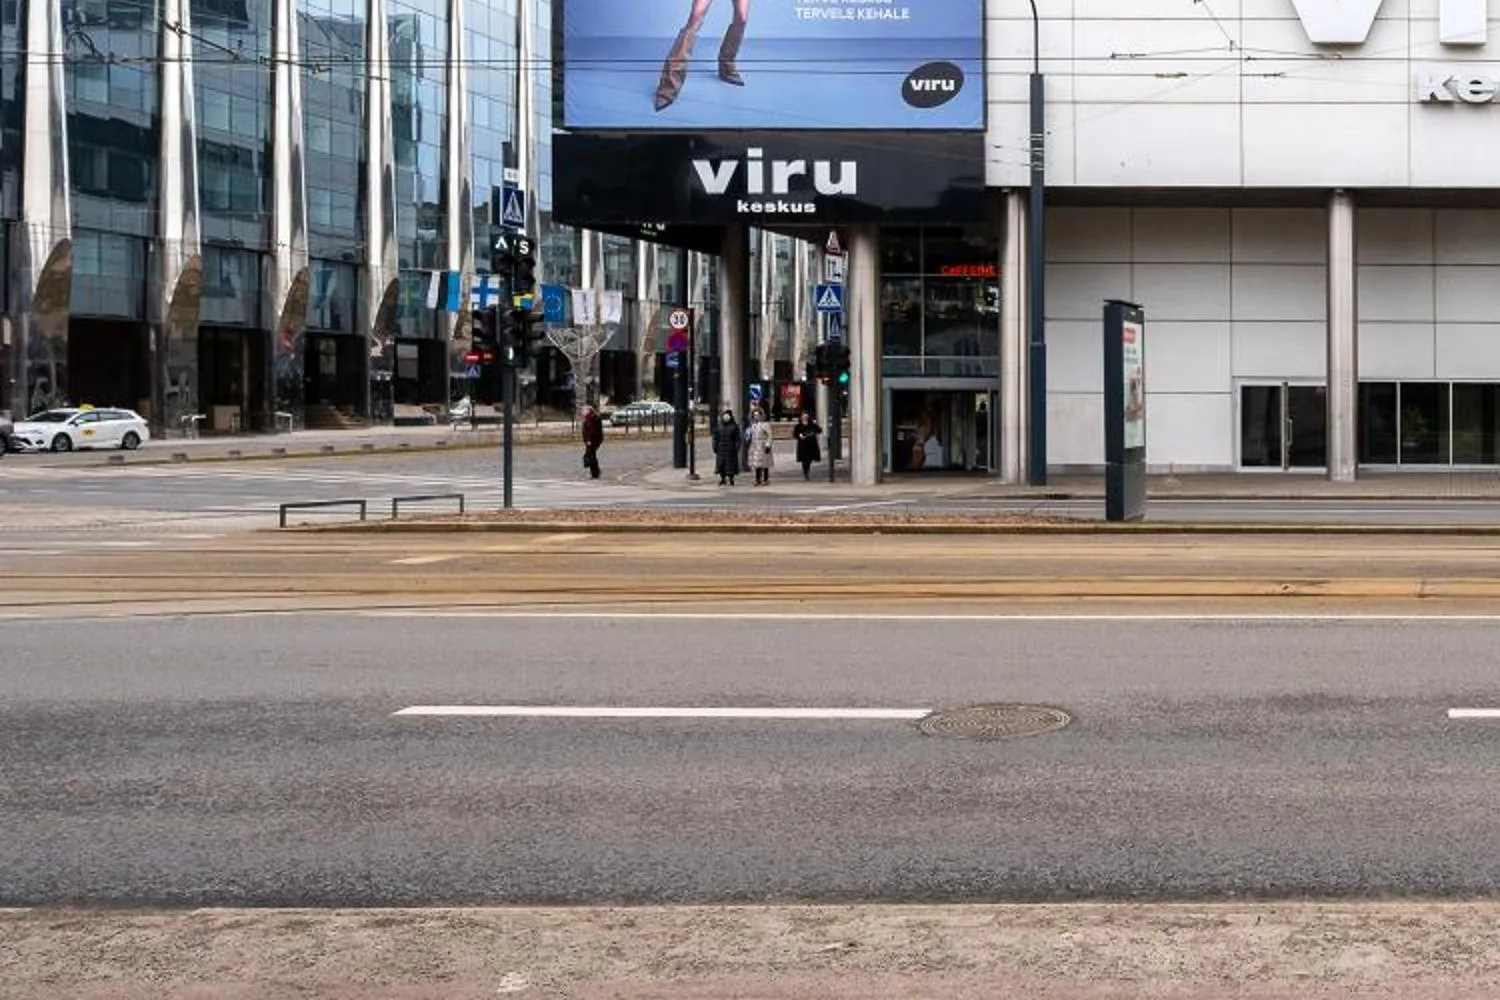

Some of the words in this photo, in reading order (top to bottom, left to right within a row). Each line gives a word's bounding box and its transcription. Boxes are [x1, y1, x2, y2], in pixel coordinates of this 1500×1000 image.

[795, 7, 855, 20] TERVELE
[857, 7, 910, 20] KEHALE
[909, 78, 955, 91] viru
[692, 147, 858, 195] viru
[737, 200, 816, 213] keskus
